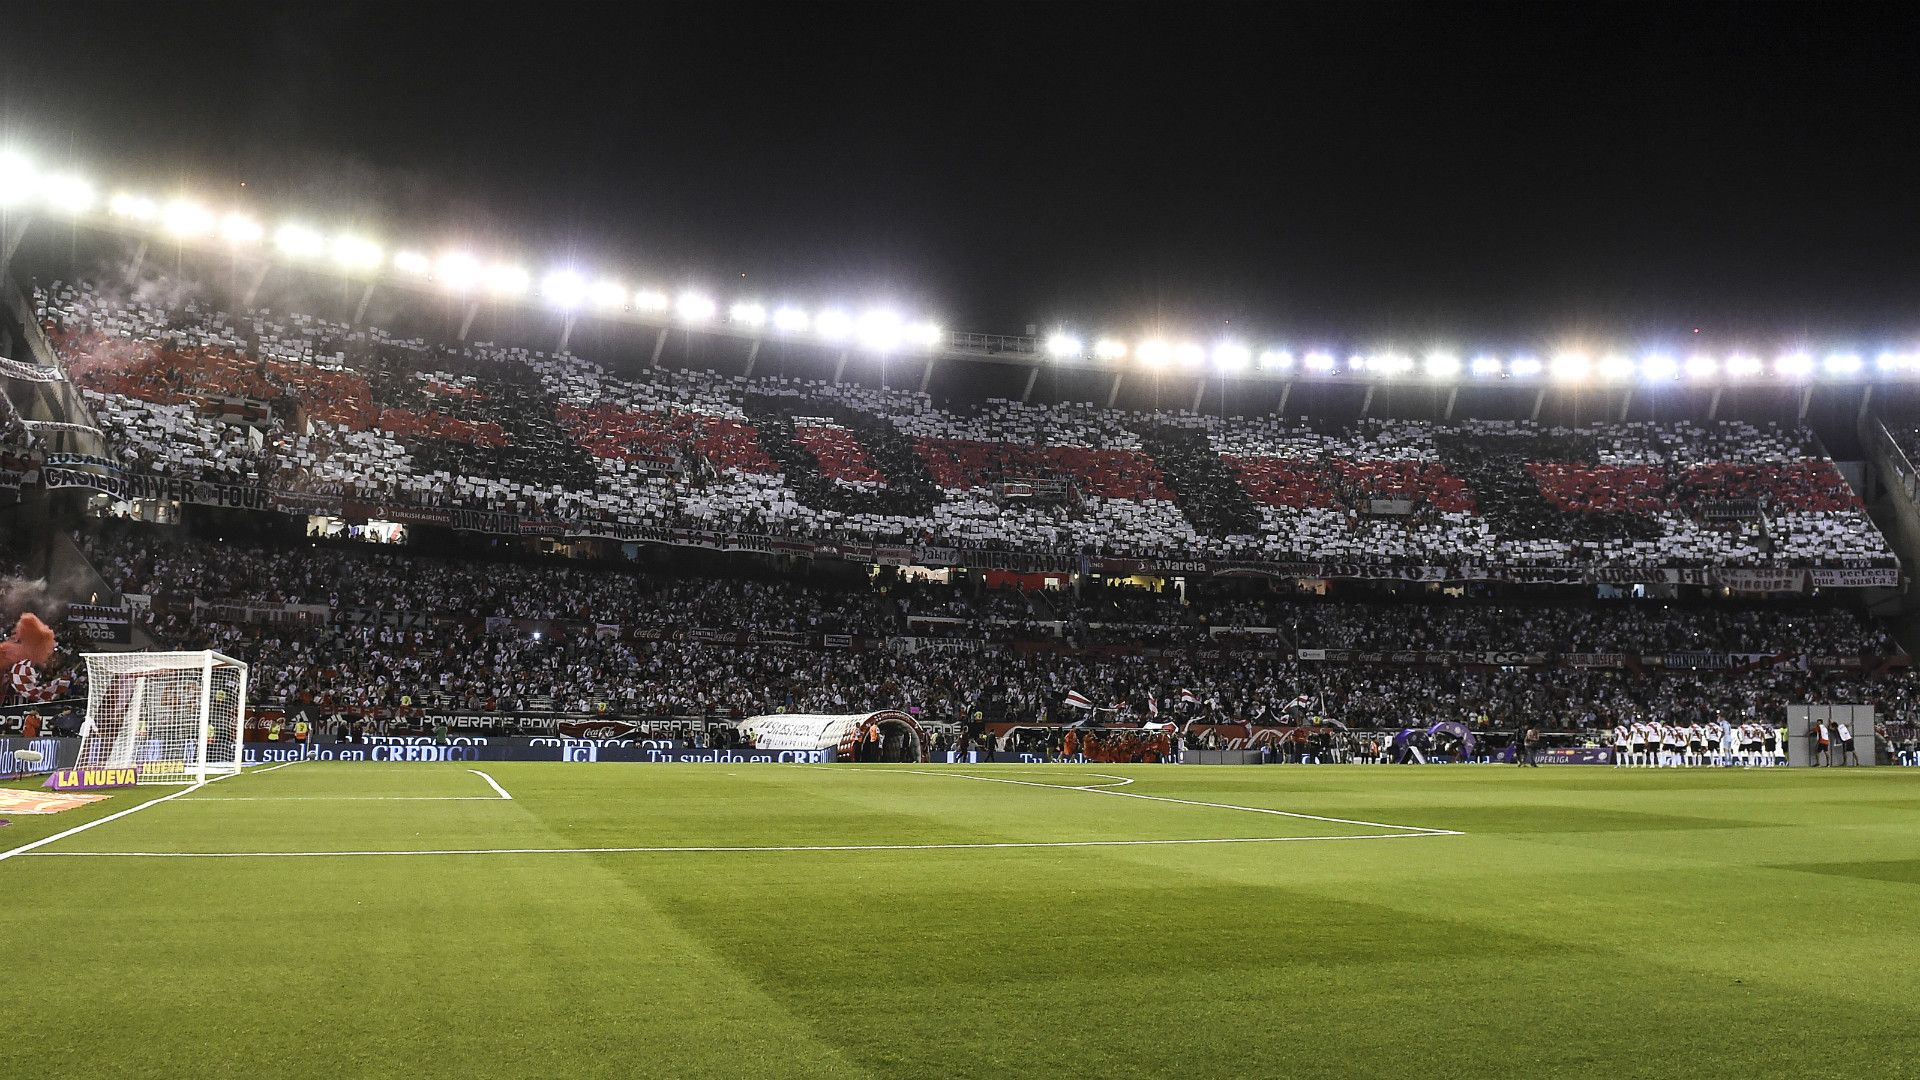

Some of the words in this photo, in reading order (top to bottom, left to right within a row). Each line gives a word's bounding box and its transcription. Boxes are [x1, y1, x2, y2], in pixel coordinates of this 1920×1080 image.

[129, 472, 194, 501] RIVER
[214, 484, 270, 513] TOUR
[390, 509, 420, 519] TURKISH
[421, 512, 450, 523] AIRLINES
[687, 530, 703, 545] ES
[714, 533, 730, 550] DE
[737, 534, 773, 552] RIVER
[1814, 577, 1835, 587] que
[263, 743, 333, 762] sueldo
[339, 749, 364, 761] en
[646, 749, 672, 763] Tu
[680, 749, 739, 763] sueldo
[749, 754, 772, 763] en
[58, 770, 79, 788] LA
[85, 769, 136, 787] NUEVA
